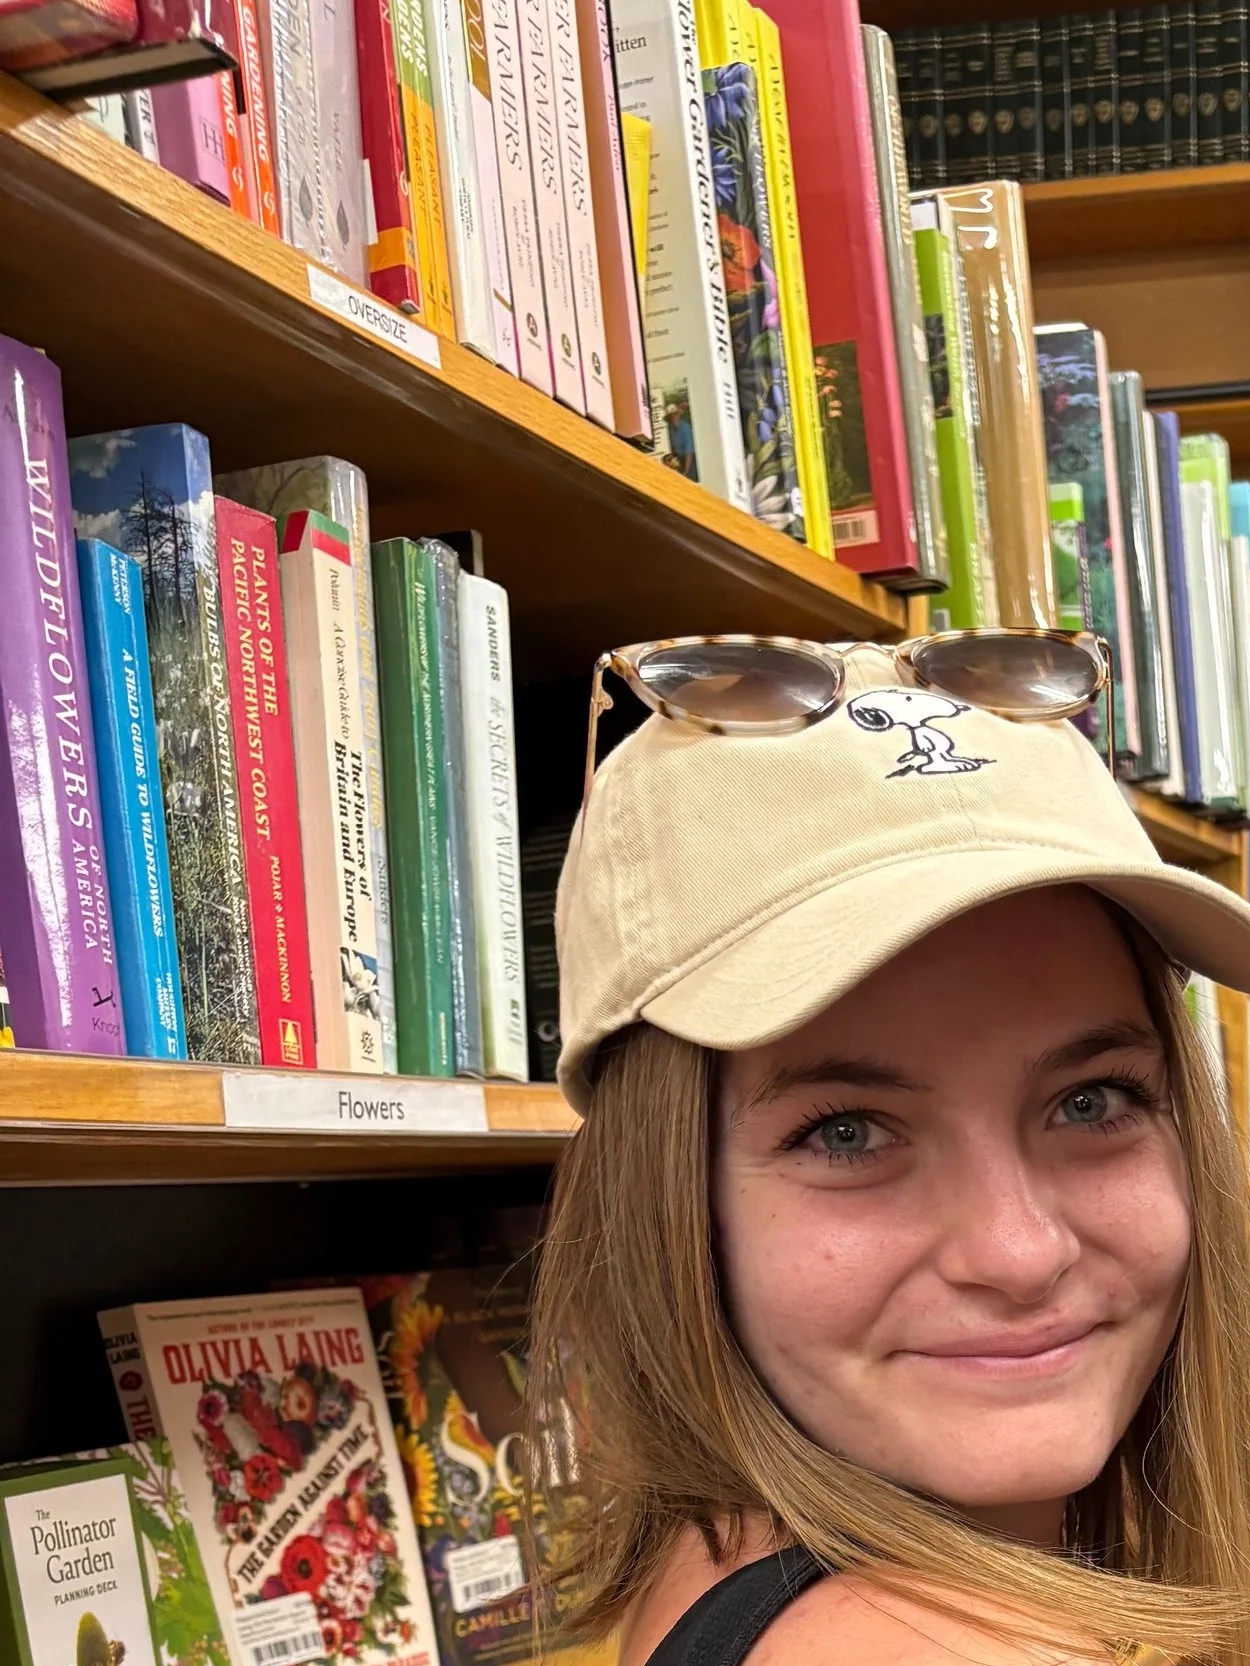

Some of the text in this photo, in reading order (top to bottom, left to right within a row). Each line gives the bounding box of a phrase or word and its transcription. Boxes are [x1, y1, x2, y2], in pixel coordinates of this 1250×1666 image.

[241, 6, 269, 165] GARDENING
[528, 15, 557, 196] FARMERS
[558, 44, 588, 217] FARMERS
[410, 111, 427, 214] PLEASANT
[424, 123, 441, 225] PLEASANT
[687, 98, 730, 364] Gardener's Bible
[348, 295, 410, 344] OVERSIZE
[118, 557, 132, 616] PETERSON
[250, 545, 279, 717] PLANTS OF THE
[230, 537, 272, 841] PACIFIC NORTHWEST COAST
[334, 636, 349, 721] Concise Guide
[486, 605, 502, 682] SANDERS
[26, 458, 114, 966] WILDFLOWERS OF NORTH
[203, 585, 242, 885] BULBS OF NORTH AMERICA
[122, 648, 165, 939] A FIELD GUIDE TO WILDFLOWERS
[489, 719, 510, 809] SECRETS
[334, 741, 360, 943] Britain and Europe
[350, 751, 373, 902] The Flowers of
[71, 837, 98, 950] AMERICA
[269, 854, 292, 1004] POJAR MACKINNON
[376, 854, 390, 925] Sanders
[497, 835, 521, 983] WILDFLOWERS
[337, 1091, 405, 1120] Flowers
[110, 1347, 141, 1364] LAING
[162, 1335, 273, 1385] OLIVIA
[277, 1327, 366, 1375] LAING
[126, 1395, 157, 1444] THE
[30, 1516, 117, 1556] Pollinator
[35, 1508, 51, 1522] The
[237, 1551, 266, 1584] THE
[256, 1502, 303, 1559] GARDEN
[297, 1453, 345, 1512] AGAINST
[337, 1423, 369, 1462] TIME
[46, 1550, 115, 1584] Garden
[54, 1580, 119, 1607] PLANNING DECK
[454, 1601, 531, 1639] CAMILLE
